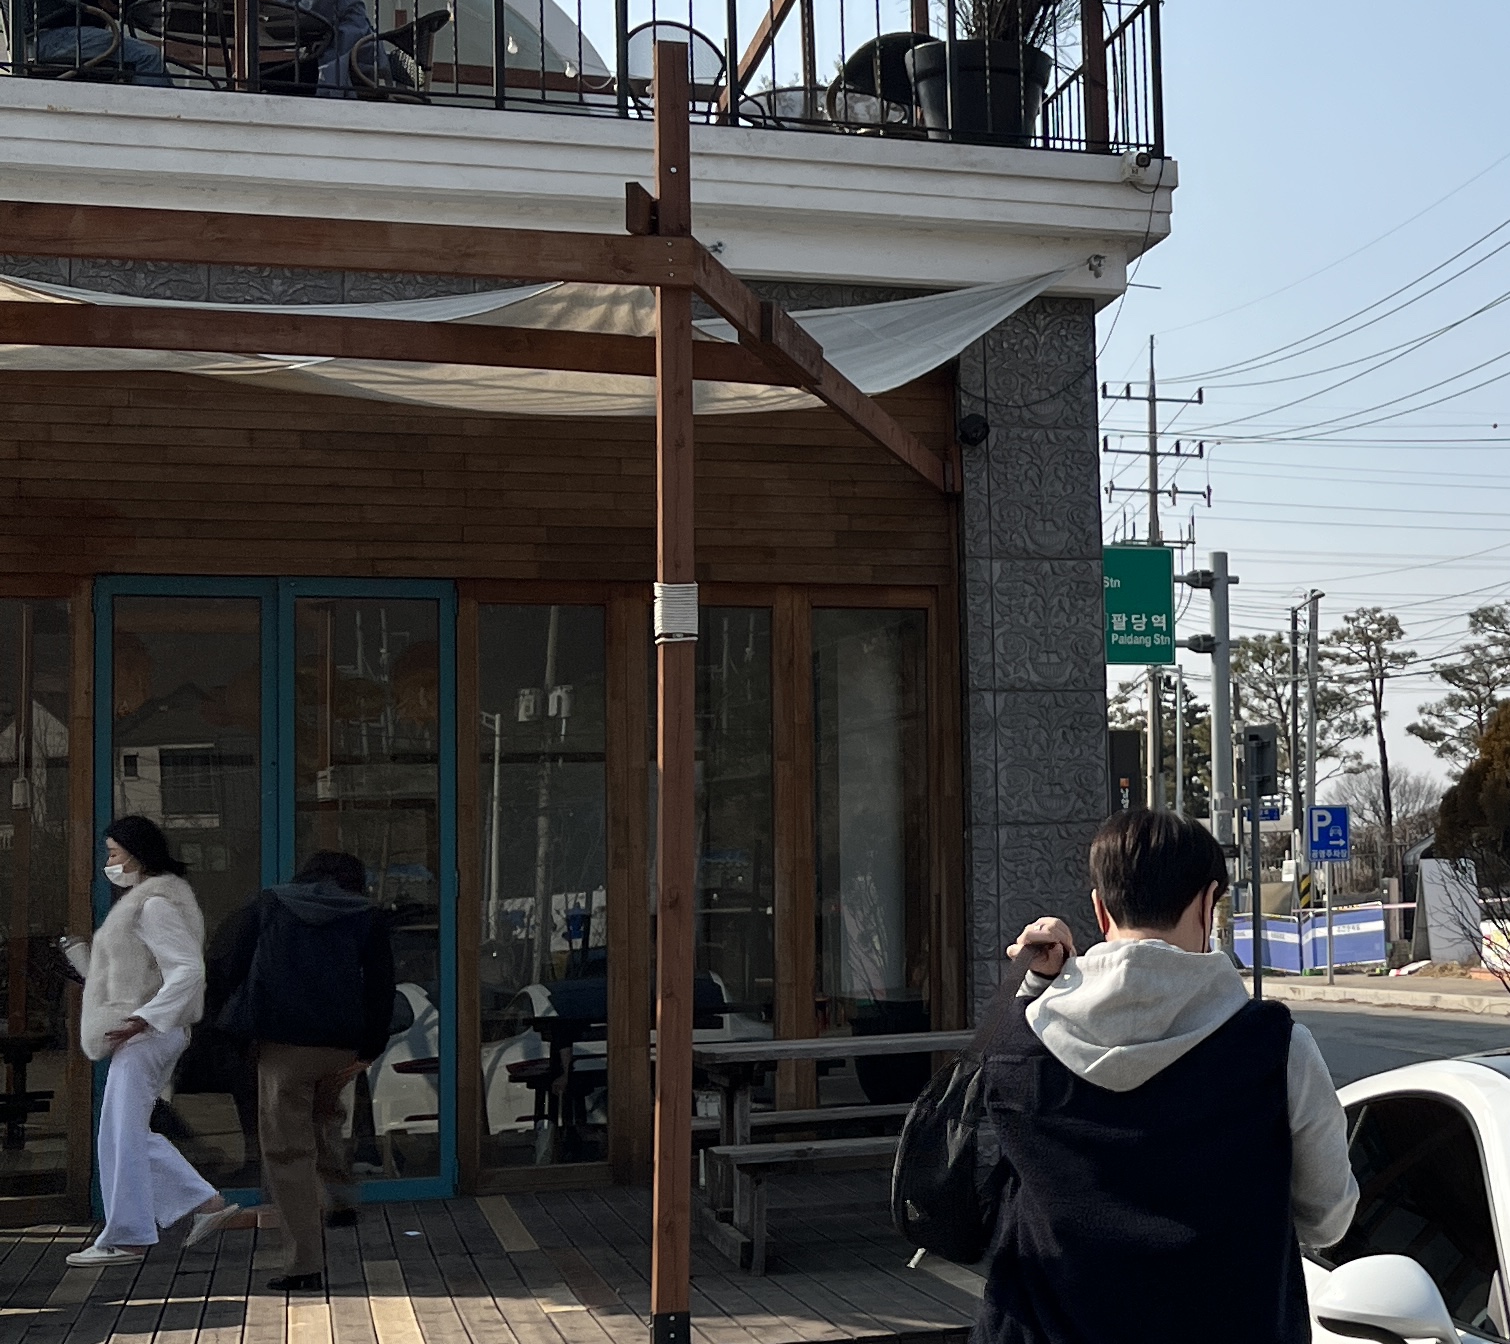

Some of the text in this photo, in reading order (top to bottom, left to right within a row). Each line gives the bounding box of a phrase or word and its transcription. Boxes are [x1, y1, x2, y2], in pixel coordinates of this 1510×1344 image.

[1111, 613, 1167, 632] 팔당역
[1111, 633, 1171, 647] Paldang Stn
[1311, 809, 1332, 842] P
